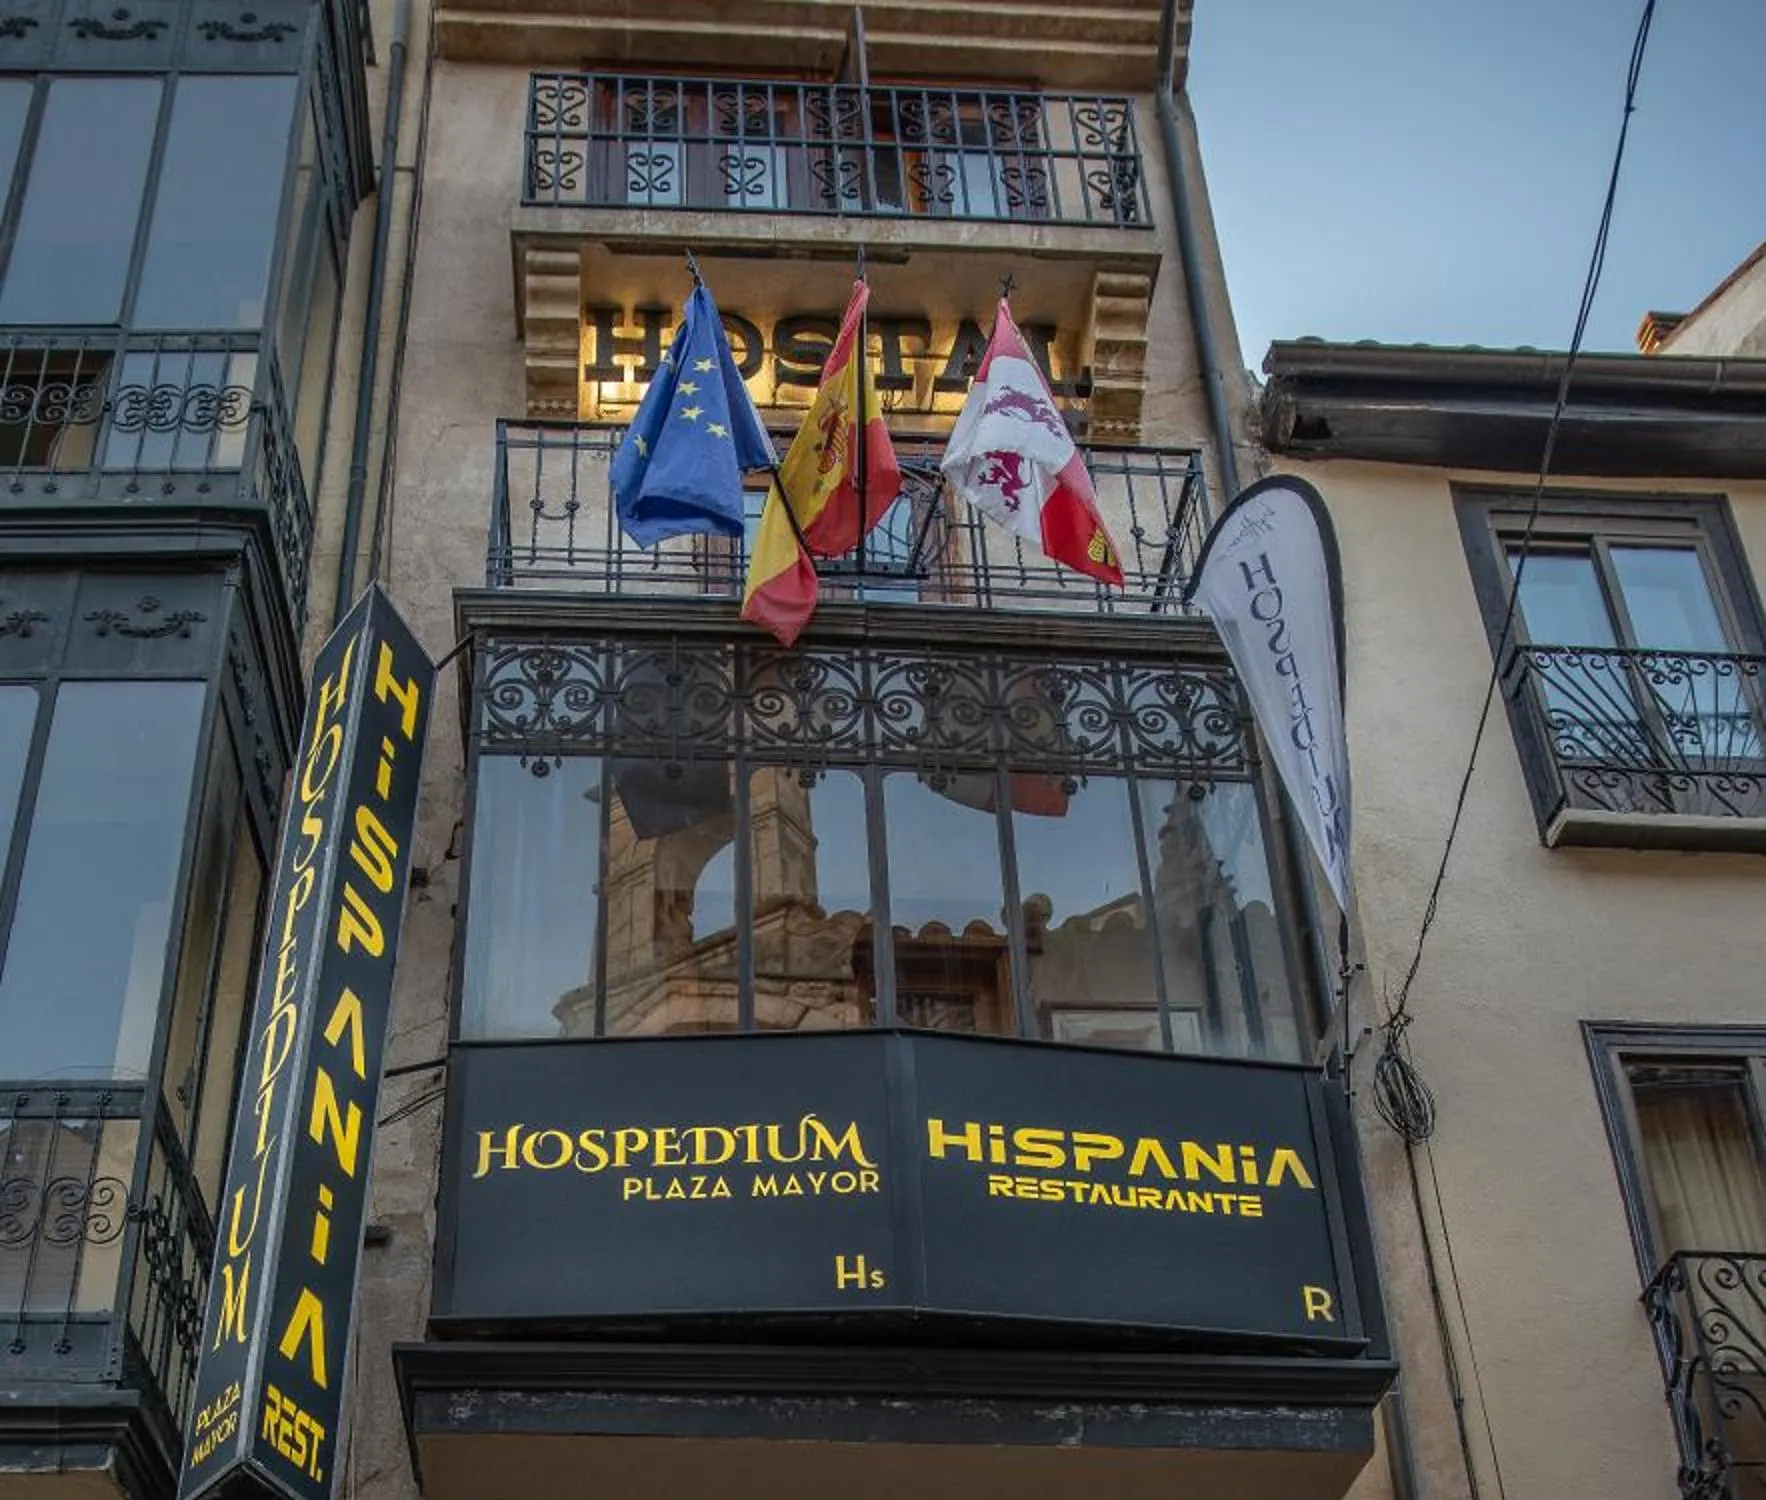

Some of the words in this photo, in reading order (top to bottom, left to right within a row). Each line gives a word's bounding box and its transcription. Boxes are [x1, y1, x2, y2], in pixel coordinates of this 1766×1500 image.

[213, 632, 357, 1353] HOSPEDIUM
[474, 1112, 878, 1179] HOSPEDIUM
[622, 1175, 732, 1202] PLAZA
[751, 1169, 880, 1197] MAYOR
[988, 1174, 1264, 1218] RESTAURANTE
[835, 1255, 885, 1290] Hs
[1303, 1286, 1334, 1323] R
[196, 1381, 240, 1437] PLAZA
[262, 1383, 325, 1483] REST.
